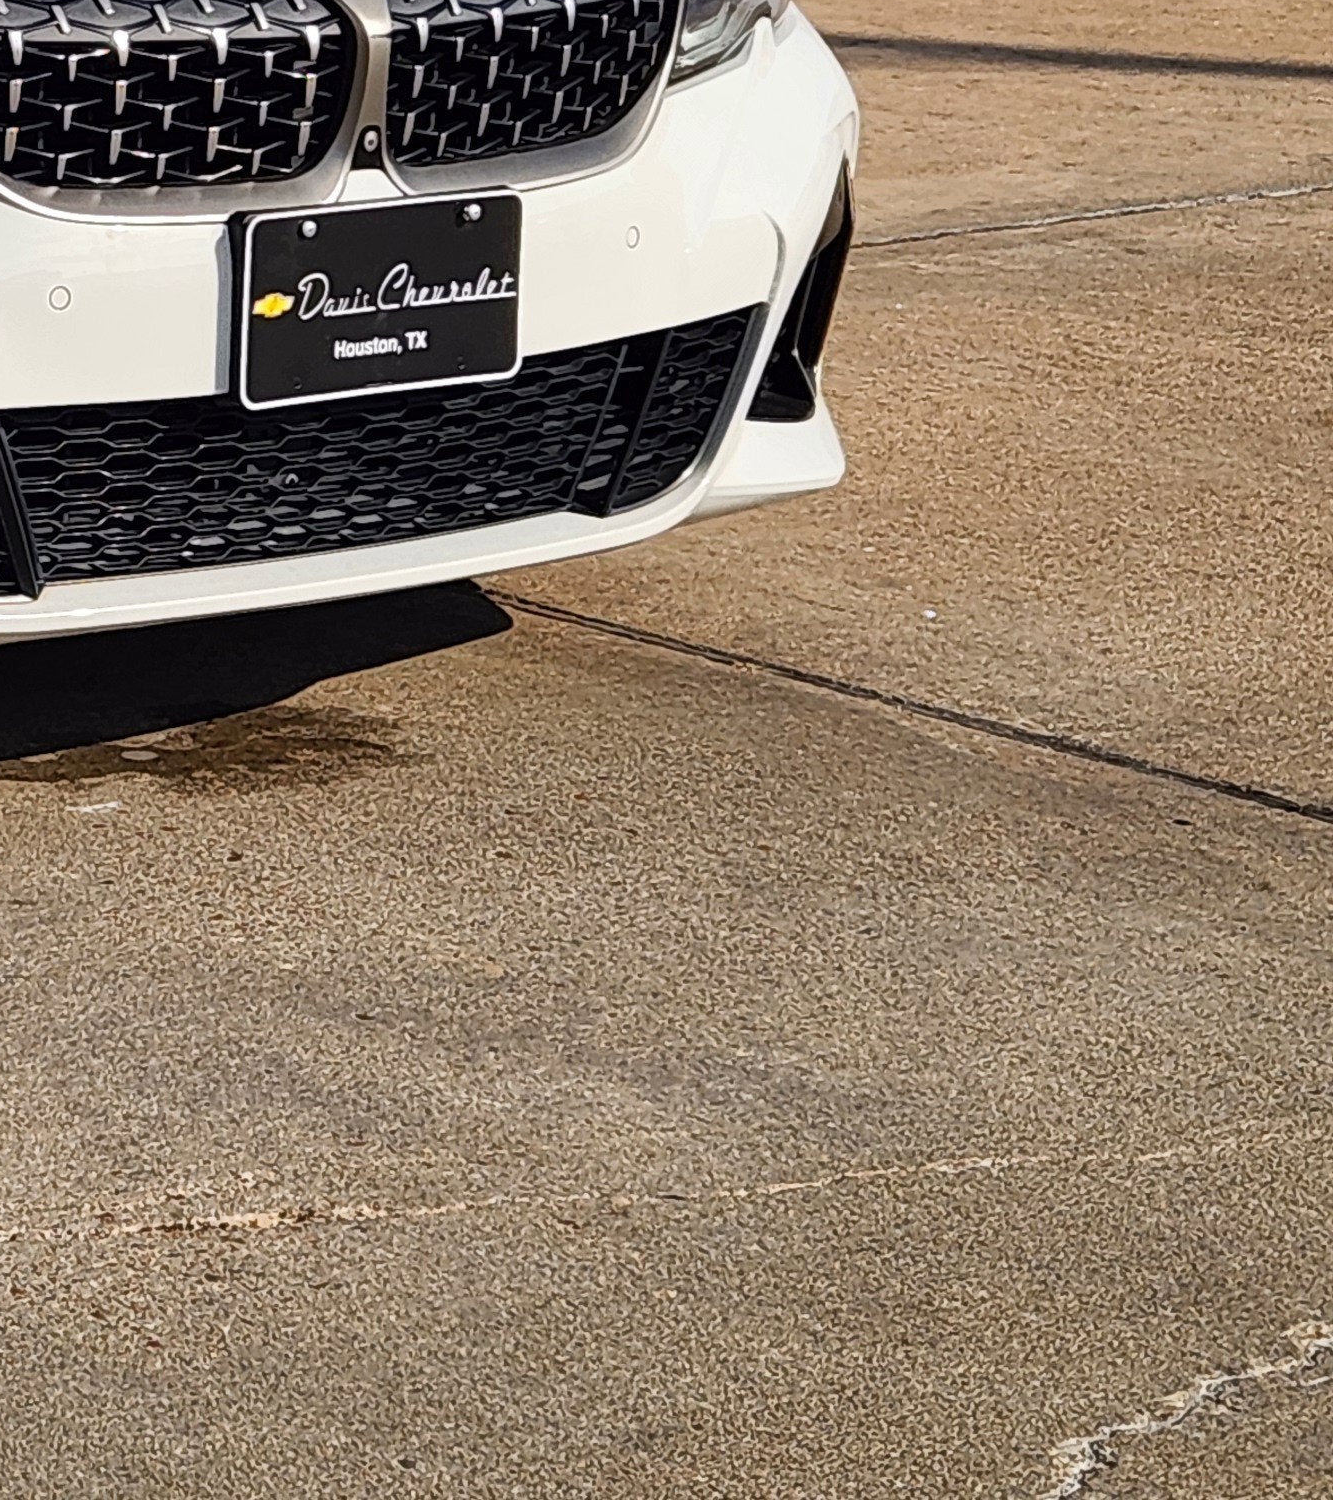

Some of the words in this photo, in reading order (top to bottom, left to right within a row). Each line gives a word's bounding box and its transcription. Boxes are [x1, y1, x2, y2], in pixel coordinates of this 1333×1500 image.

[297, 272, 376, 321] Davis
[376, 262, 518, 310] Chevrolet
[333, 335, 403, 360] Houston,
[404, 330, 428, 351] TX
